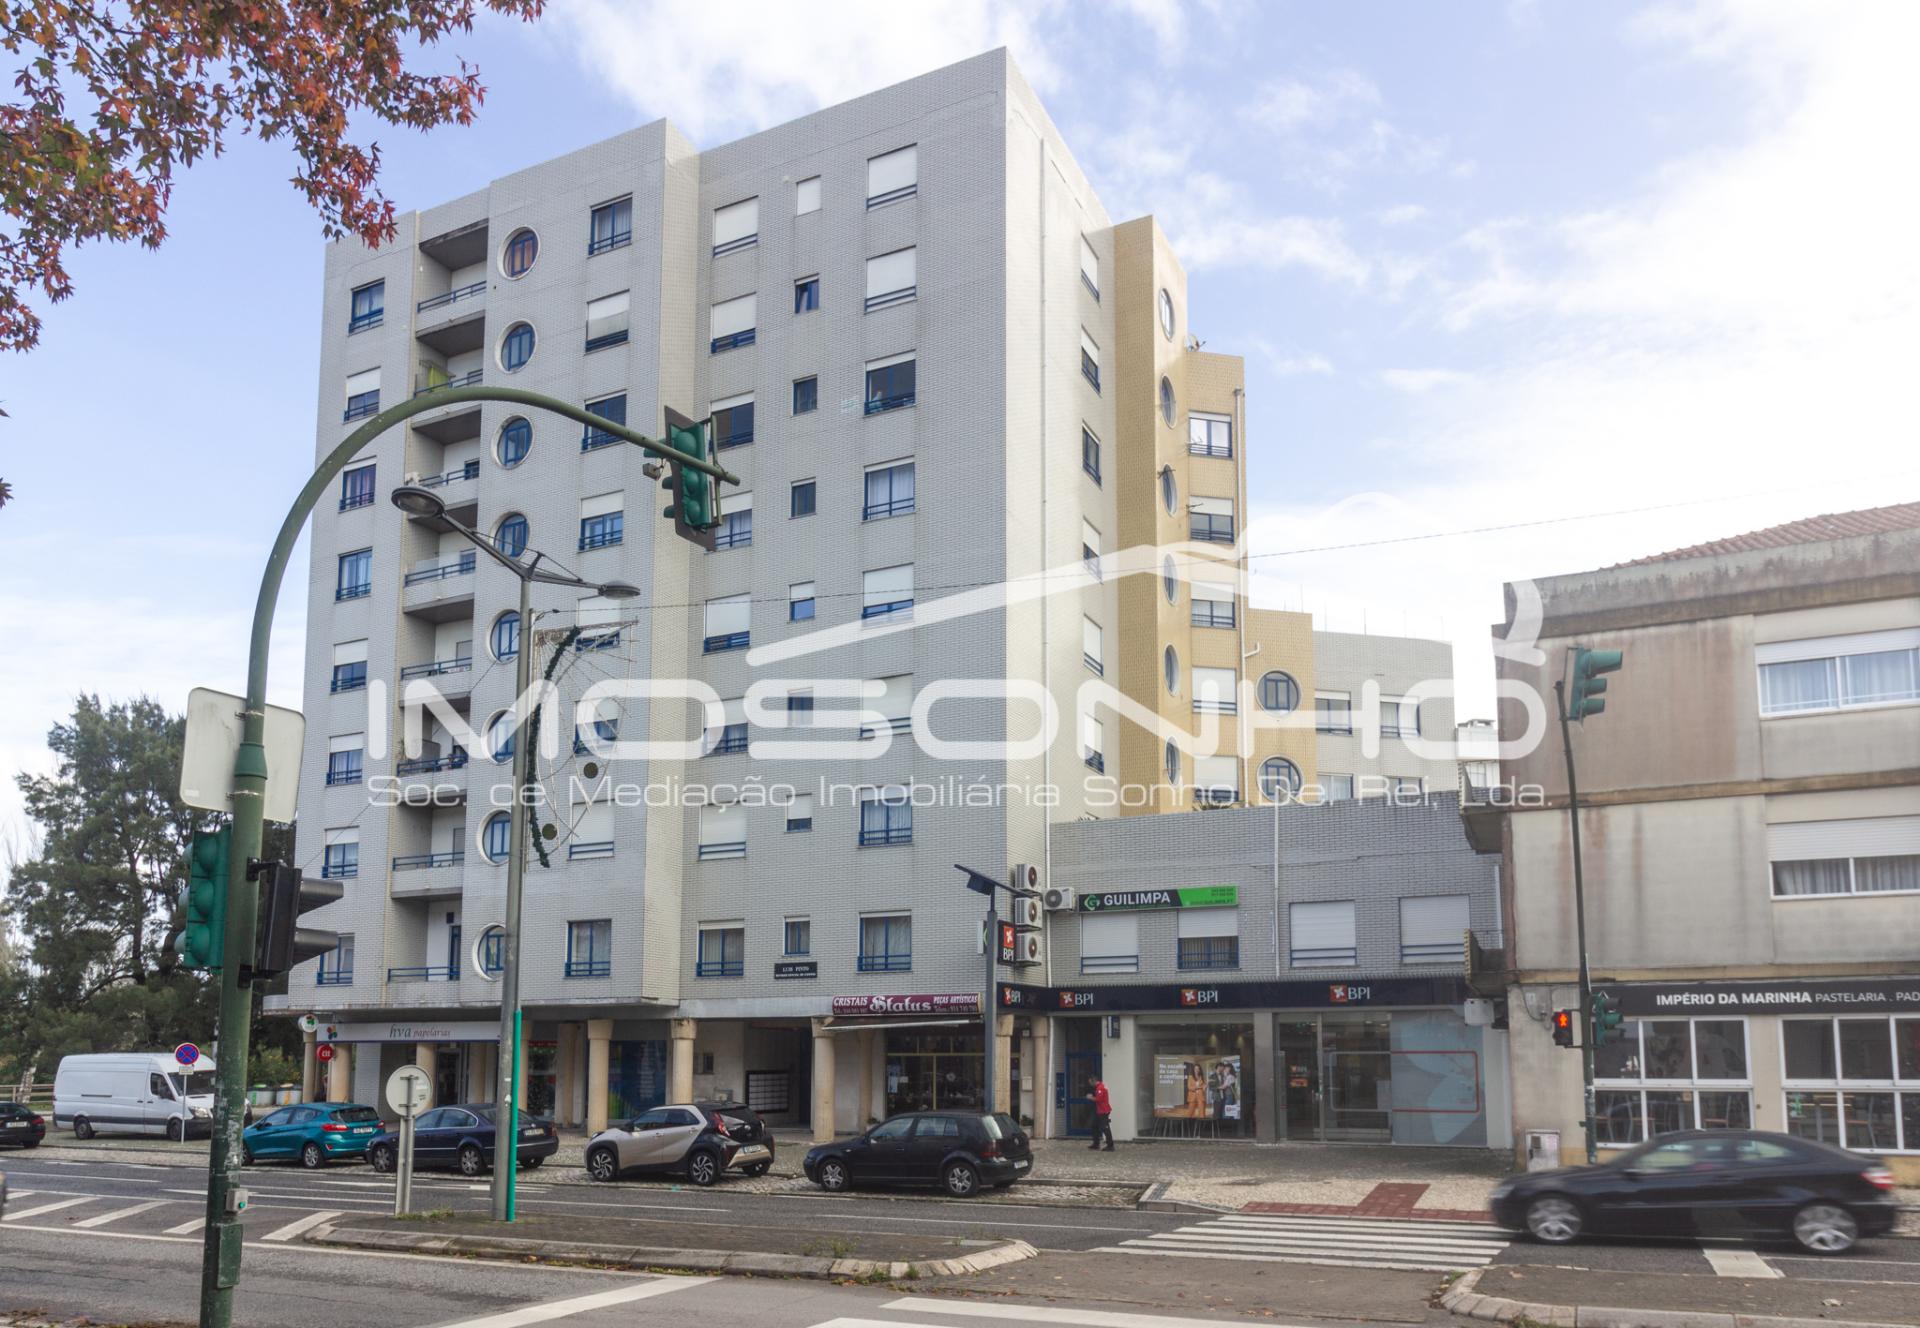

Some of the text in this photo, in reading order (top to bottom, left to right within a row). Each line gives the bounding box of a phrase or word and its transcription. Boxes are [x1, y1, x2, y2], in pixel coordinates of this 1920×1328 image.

[1103, 891, 1171, 906] GUILIMPA
[1002, 947, 1014, 961] BPI
[1074, 993, 1094, 1006] BPI
[1198, 989, 1219, 1003] BPI
[1348, 986, 1371, 1000] BPI
[1656, 991, 1920, 1005] IMPÉRIO DA MARINHA PASTELARIA PAD
[833, 996, 868, 1006] CRISTAIS
[869, 995, 932, 1013] Status
